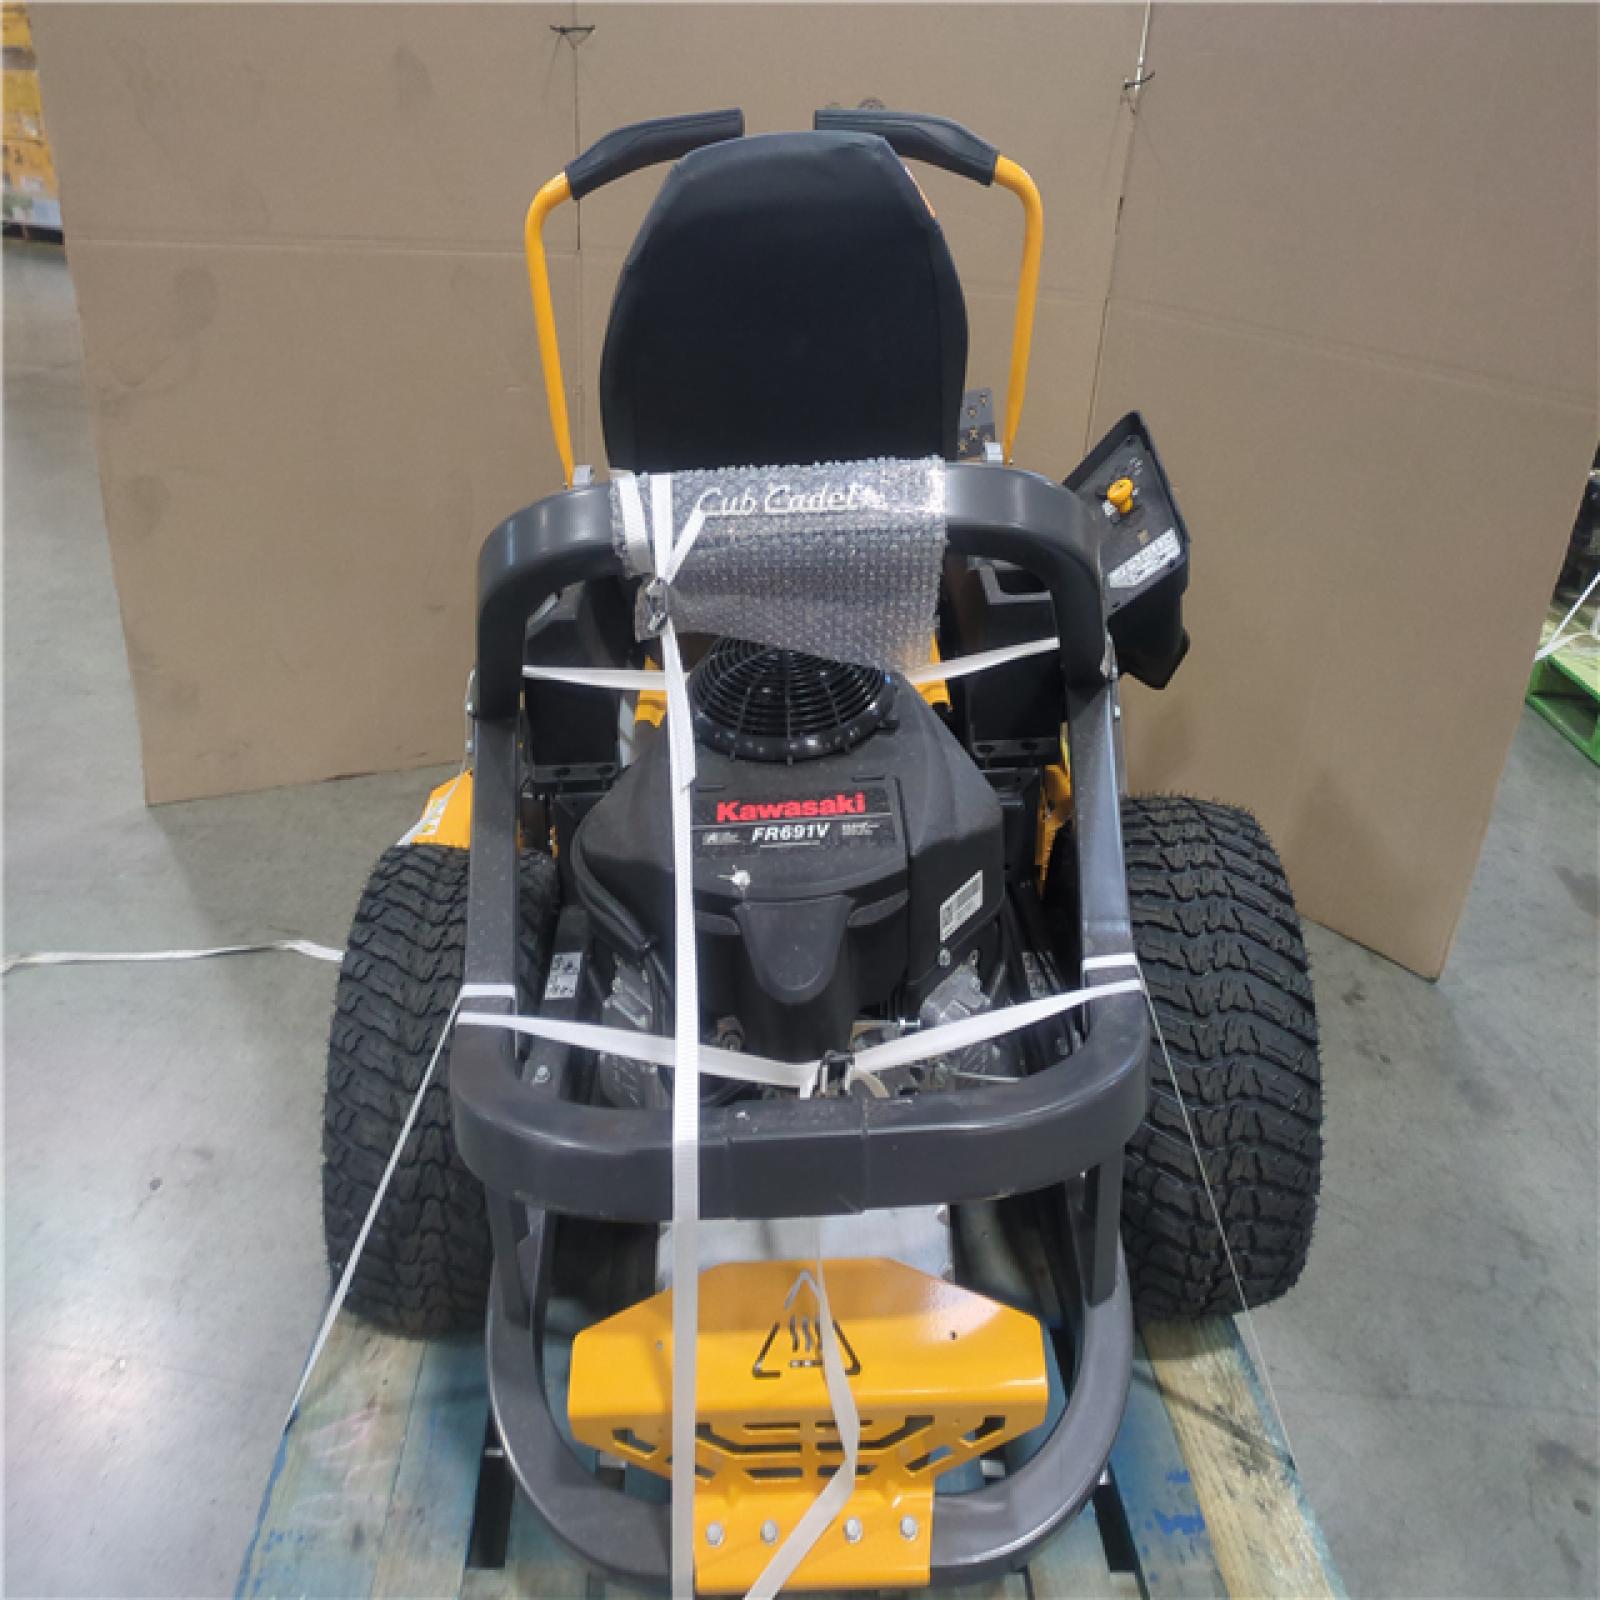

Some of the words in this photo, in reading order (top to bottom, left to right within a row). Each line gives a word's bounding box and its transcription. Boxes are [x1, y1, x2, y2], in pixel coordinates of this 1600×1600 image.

[699, 487, 757, 516] Cub
[716, 792, 866, 823] Kawasaki
[751, 822, 831, 843] FR691V
